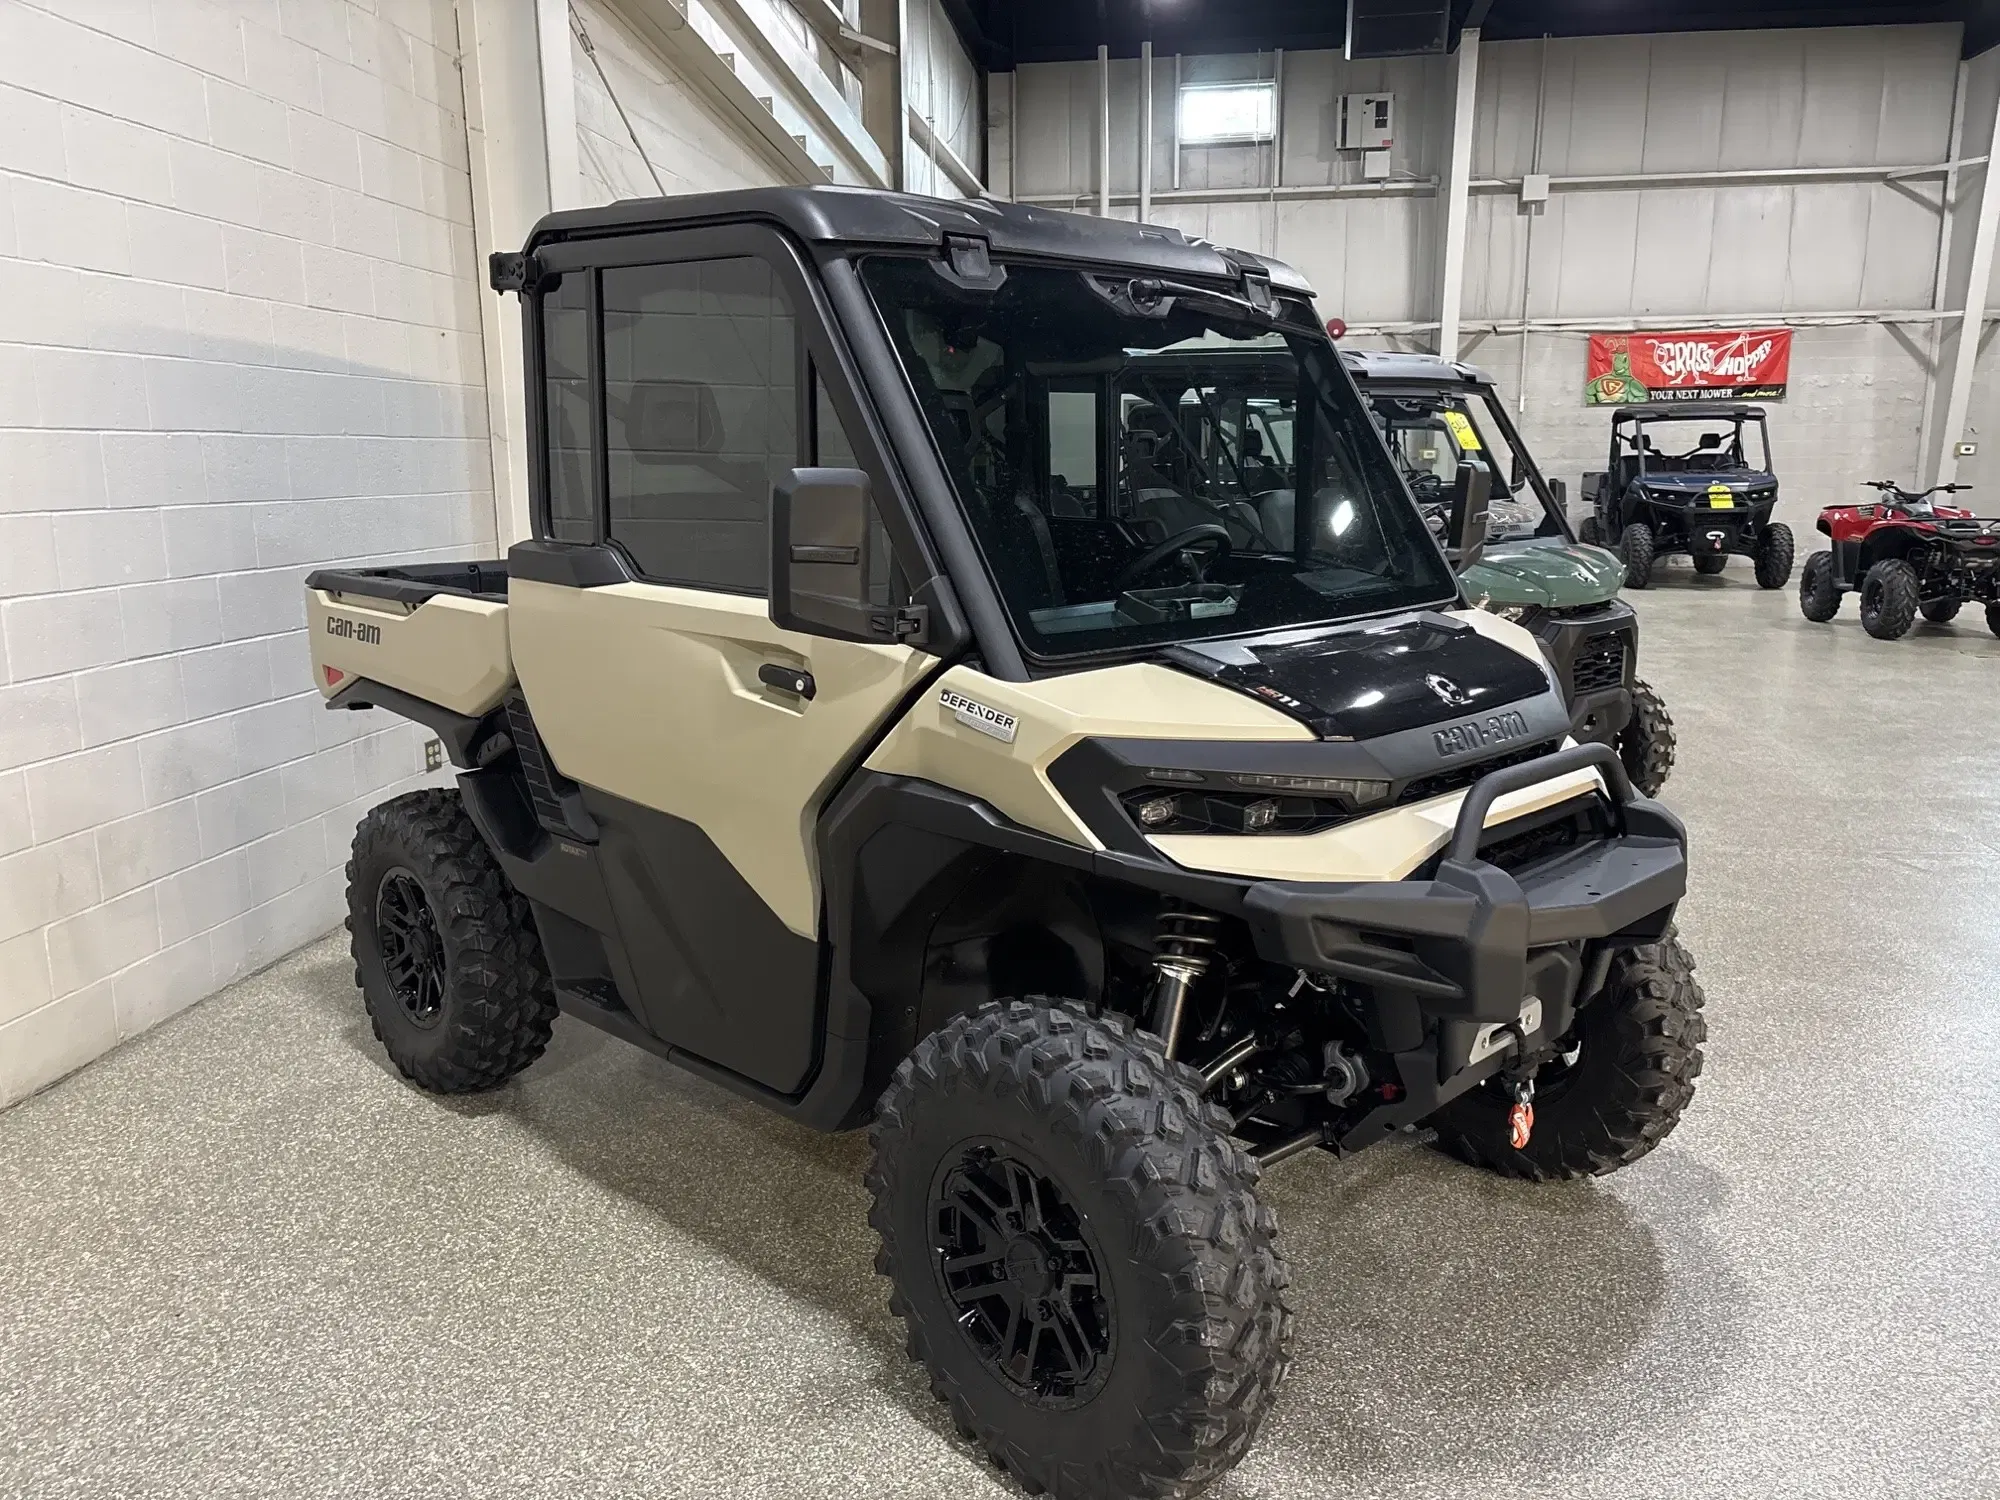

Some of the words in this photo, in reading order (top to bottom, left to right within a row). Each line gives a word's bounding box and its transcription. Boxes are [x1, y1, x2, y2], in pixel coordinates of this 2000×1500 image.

[1650, 390, 1674, 400] YOUR
[1675, 389, 1699, 400] NEXT
[1700, 388, 1733, 399] MOWER
[326, 615, 381, 645] can-am
[940, 691, 1014, 729] DEFENDER
[1432, 710, 1529, 757] can-am
